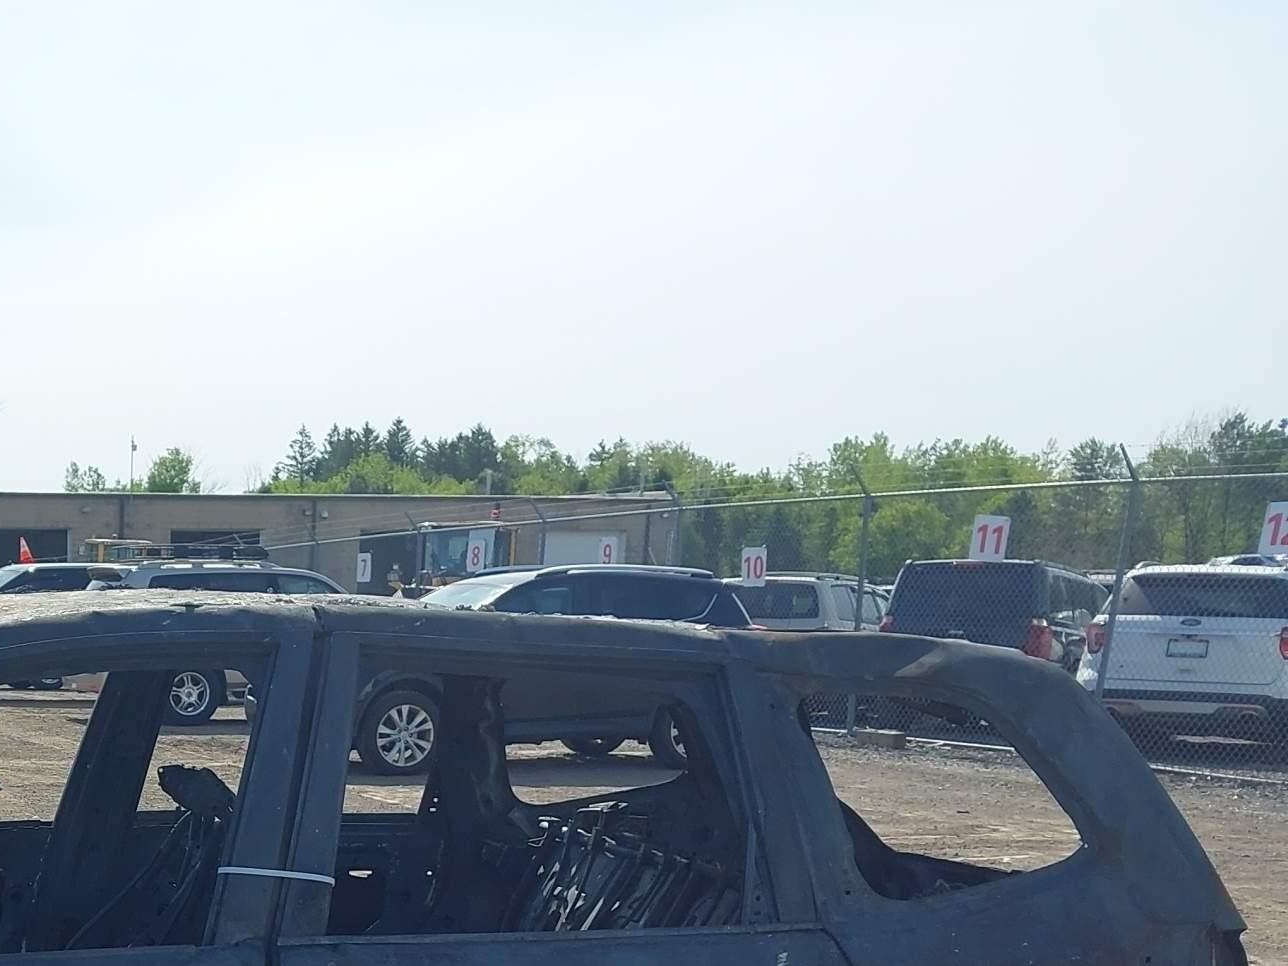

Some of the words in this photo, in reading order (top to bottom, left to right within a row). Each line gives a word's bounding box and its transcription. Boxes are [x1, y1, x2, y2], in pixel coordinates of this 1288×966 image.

[977, 524, 1004, 554] 11
[472, 545, 481, 566] 8
[602, 543, 612, 564] 9
[360, 559, 367, 577] 7
[744, 555, 764, 579] 10
